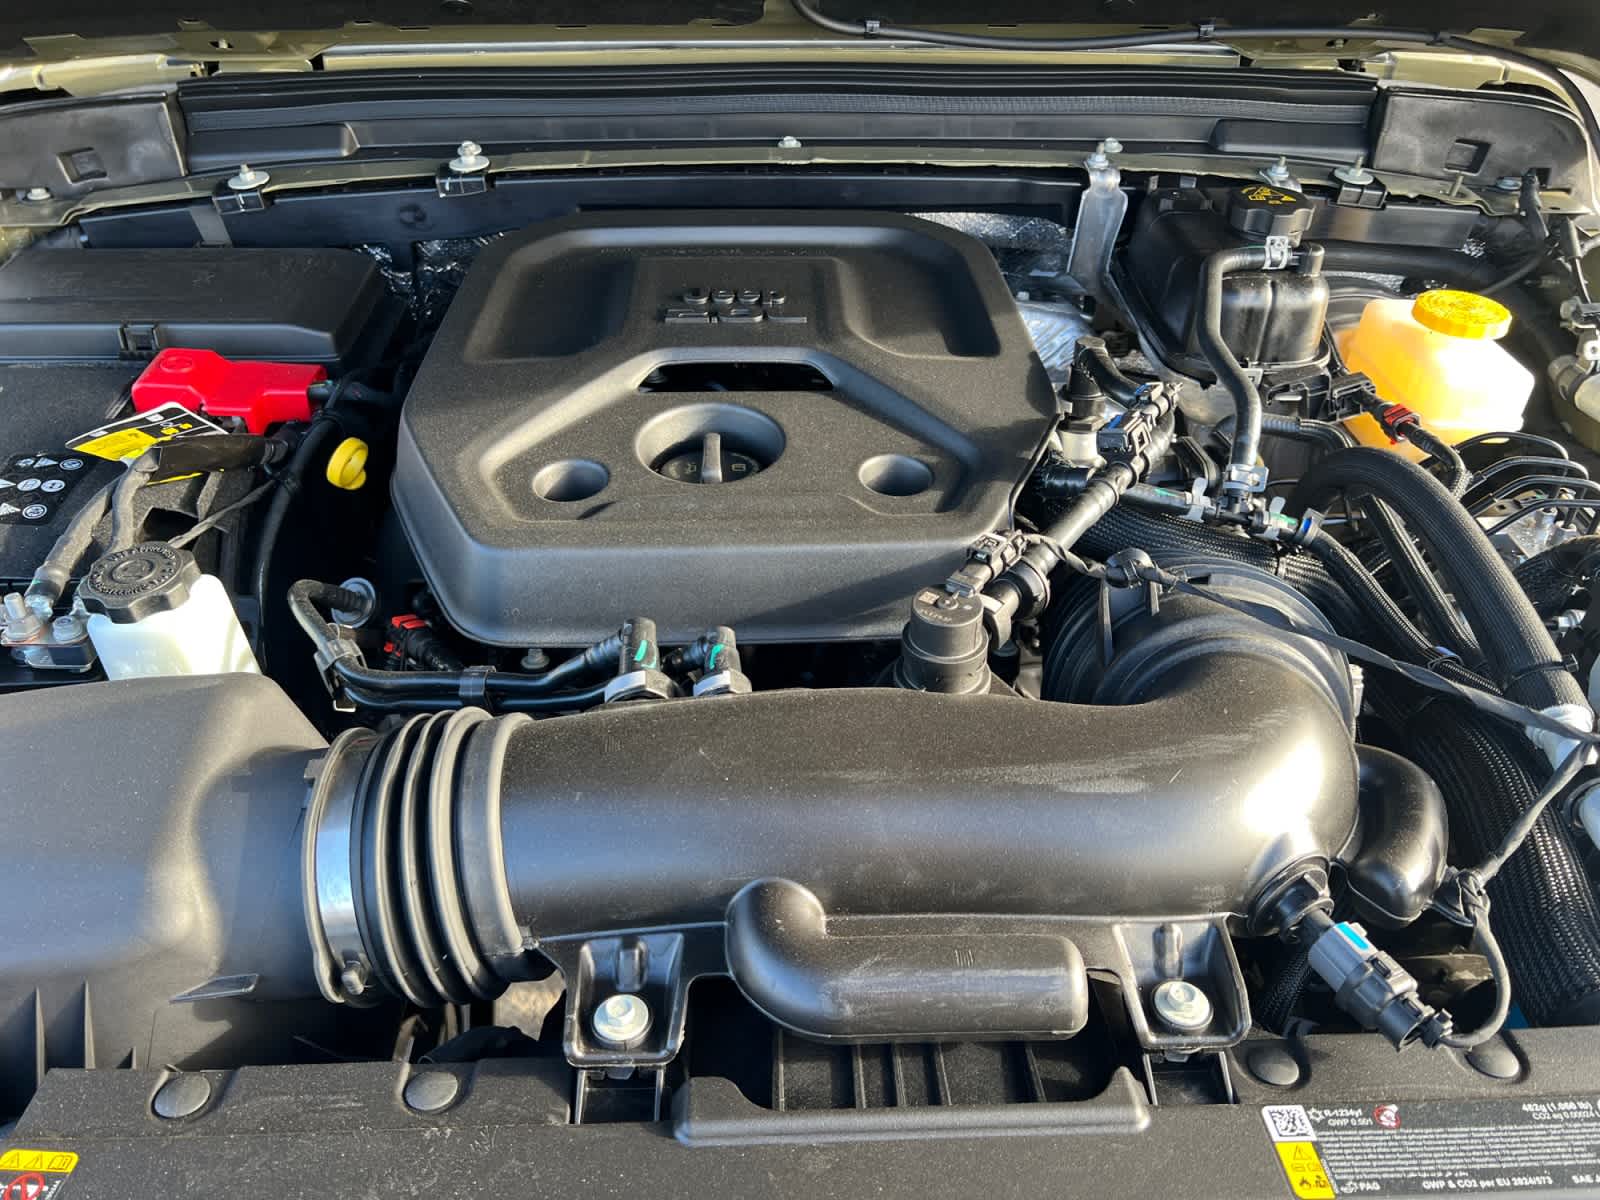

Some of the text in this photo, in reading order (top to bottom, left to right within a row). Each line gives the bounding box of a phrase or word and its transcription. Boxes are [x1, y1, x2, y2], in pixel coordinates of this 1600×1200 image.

[1359, 1182, 1381, 1191] PAG
[1422, 1180, 1446, 1190] GWP
[1457, 1179, 1478, 1188] CO2
[1495, 1177, 1511, 1187] EU
